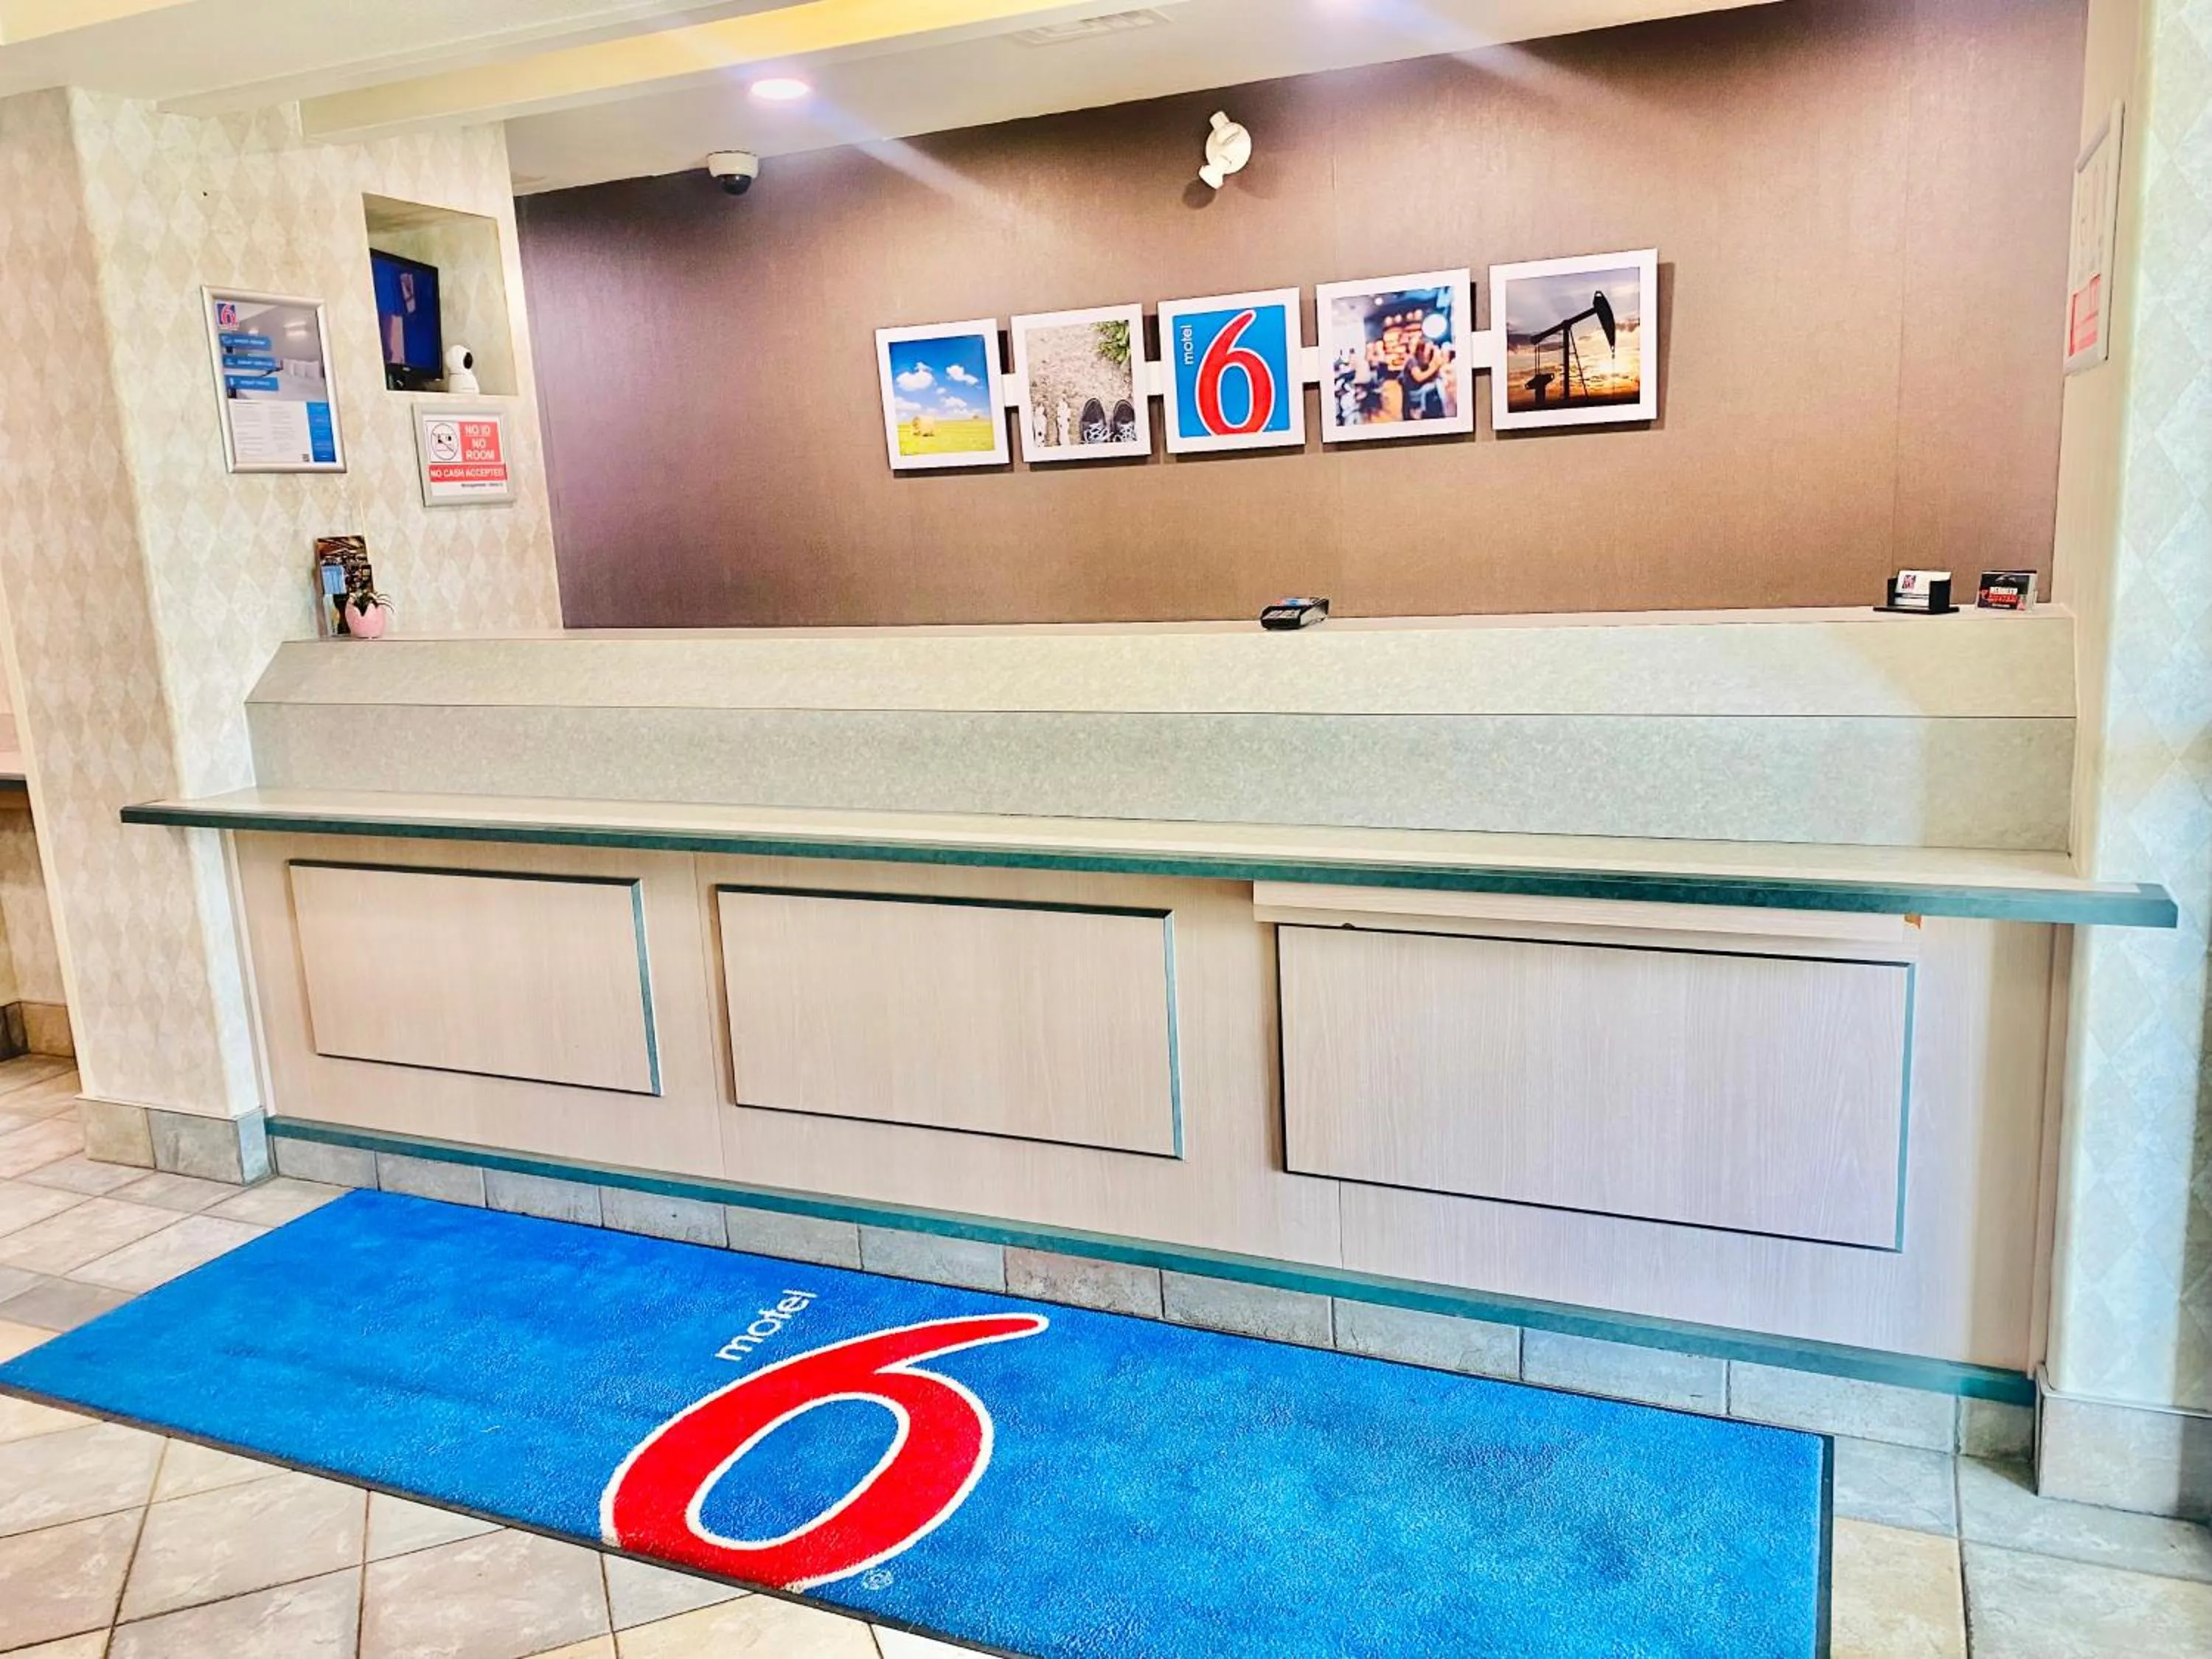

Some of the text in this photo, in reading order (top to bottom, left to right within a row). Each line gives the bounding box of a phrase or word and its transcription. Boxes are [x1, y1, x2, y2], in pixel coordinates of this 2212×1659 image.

[221, 304, 236, 325] 6
[1180, 309, 1276, 437] motel 6
[465, 425, 491, 437] NO ID
[472, 438, 487, 448] NO
[465, 450, 495, 460] ROOM
[430, 468, 504, 478] NO CASH ACCEPTED
[599, 1289, 1049, 1593] motel 6
